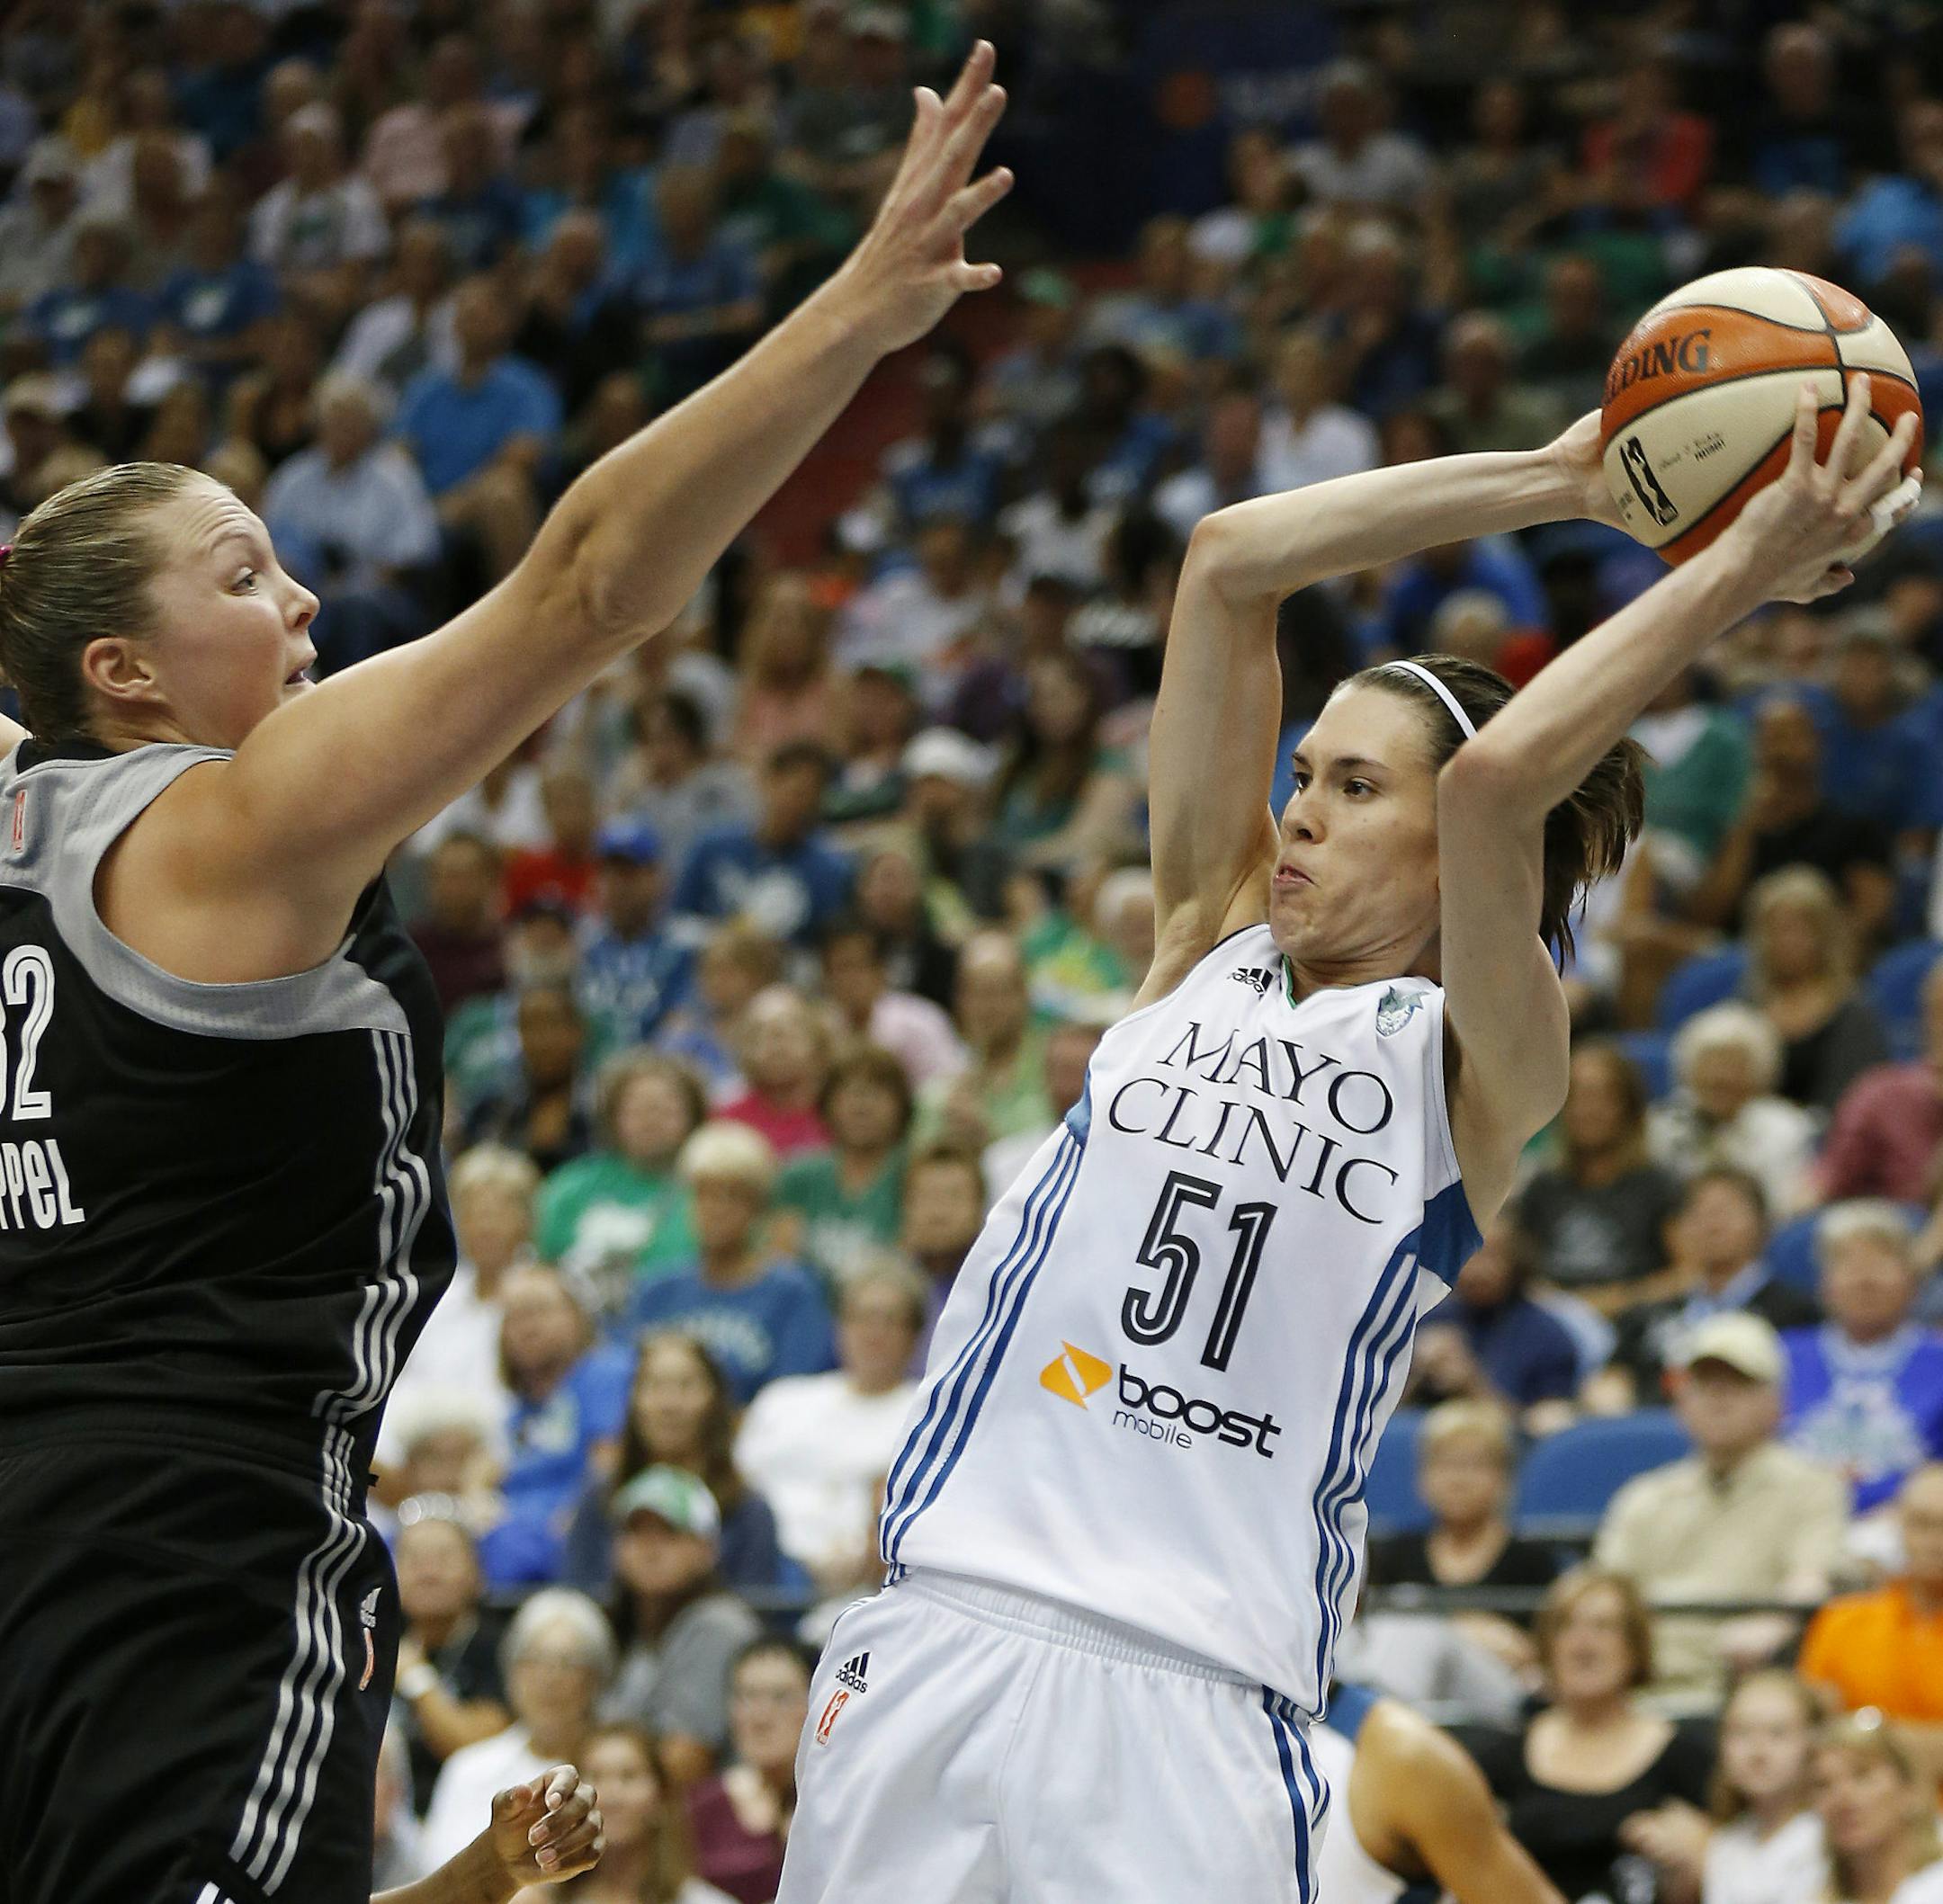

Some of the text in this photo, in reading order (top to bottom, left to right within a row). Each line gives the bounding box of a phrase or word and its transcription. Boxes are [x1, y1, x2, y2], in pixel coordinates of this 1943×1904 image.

[0, 944, 55, 1121] 2
[1157, 1021, 1393, 1134] MAYO
[1109, 1077, 1399, 1224] CLINIC
[1121, 1170, 1278, 1372] 51
[1113, 1409, 1193, 1449] mobile
[1119, 1363, 1282, 1459] boost
